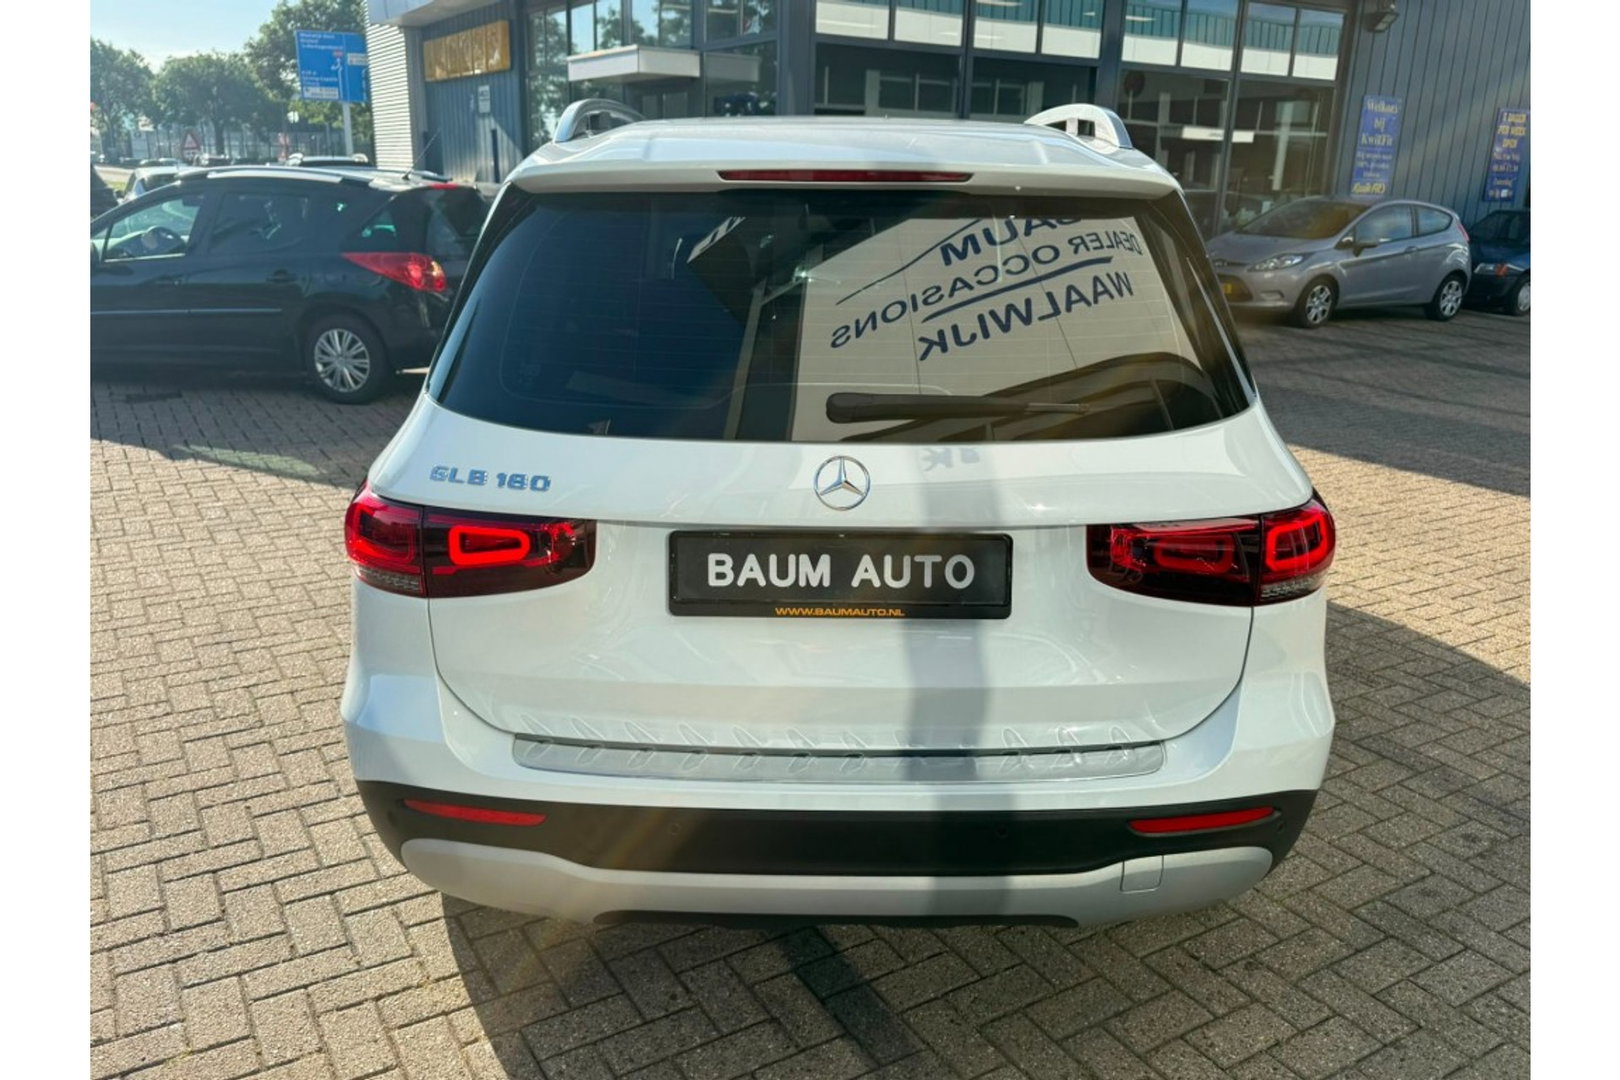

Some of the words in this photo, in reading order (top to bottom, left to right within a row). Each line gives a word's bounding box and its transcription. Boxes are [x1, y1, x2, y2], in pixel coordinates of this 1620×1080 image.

[430, 465, 488, 486] GLB
[708, 553, 831, 588] BAUM
[851, 554, 975, 589] AUTO
[775, 607, 905, 617] WWW.BAUMAUTO.NL
